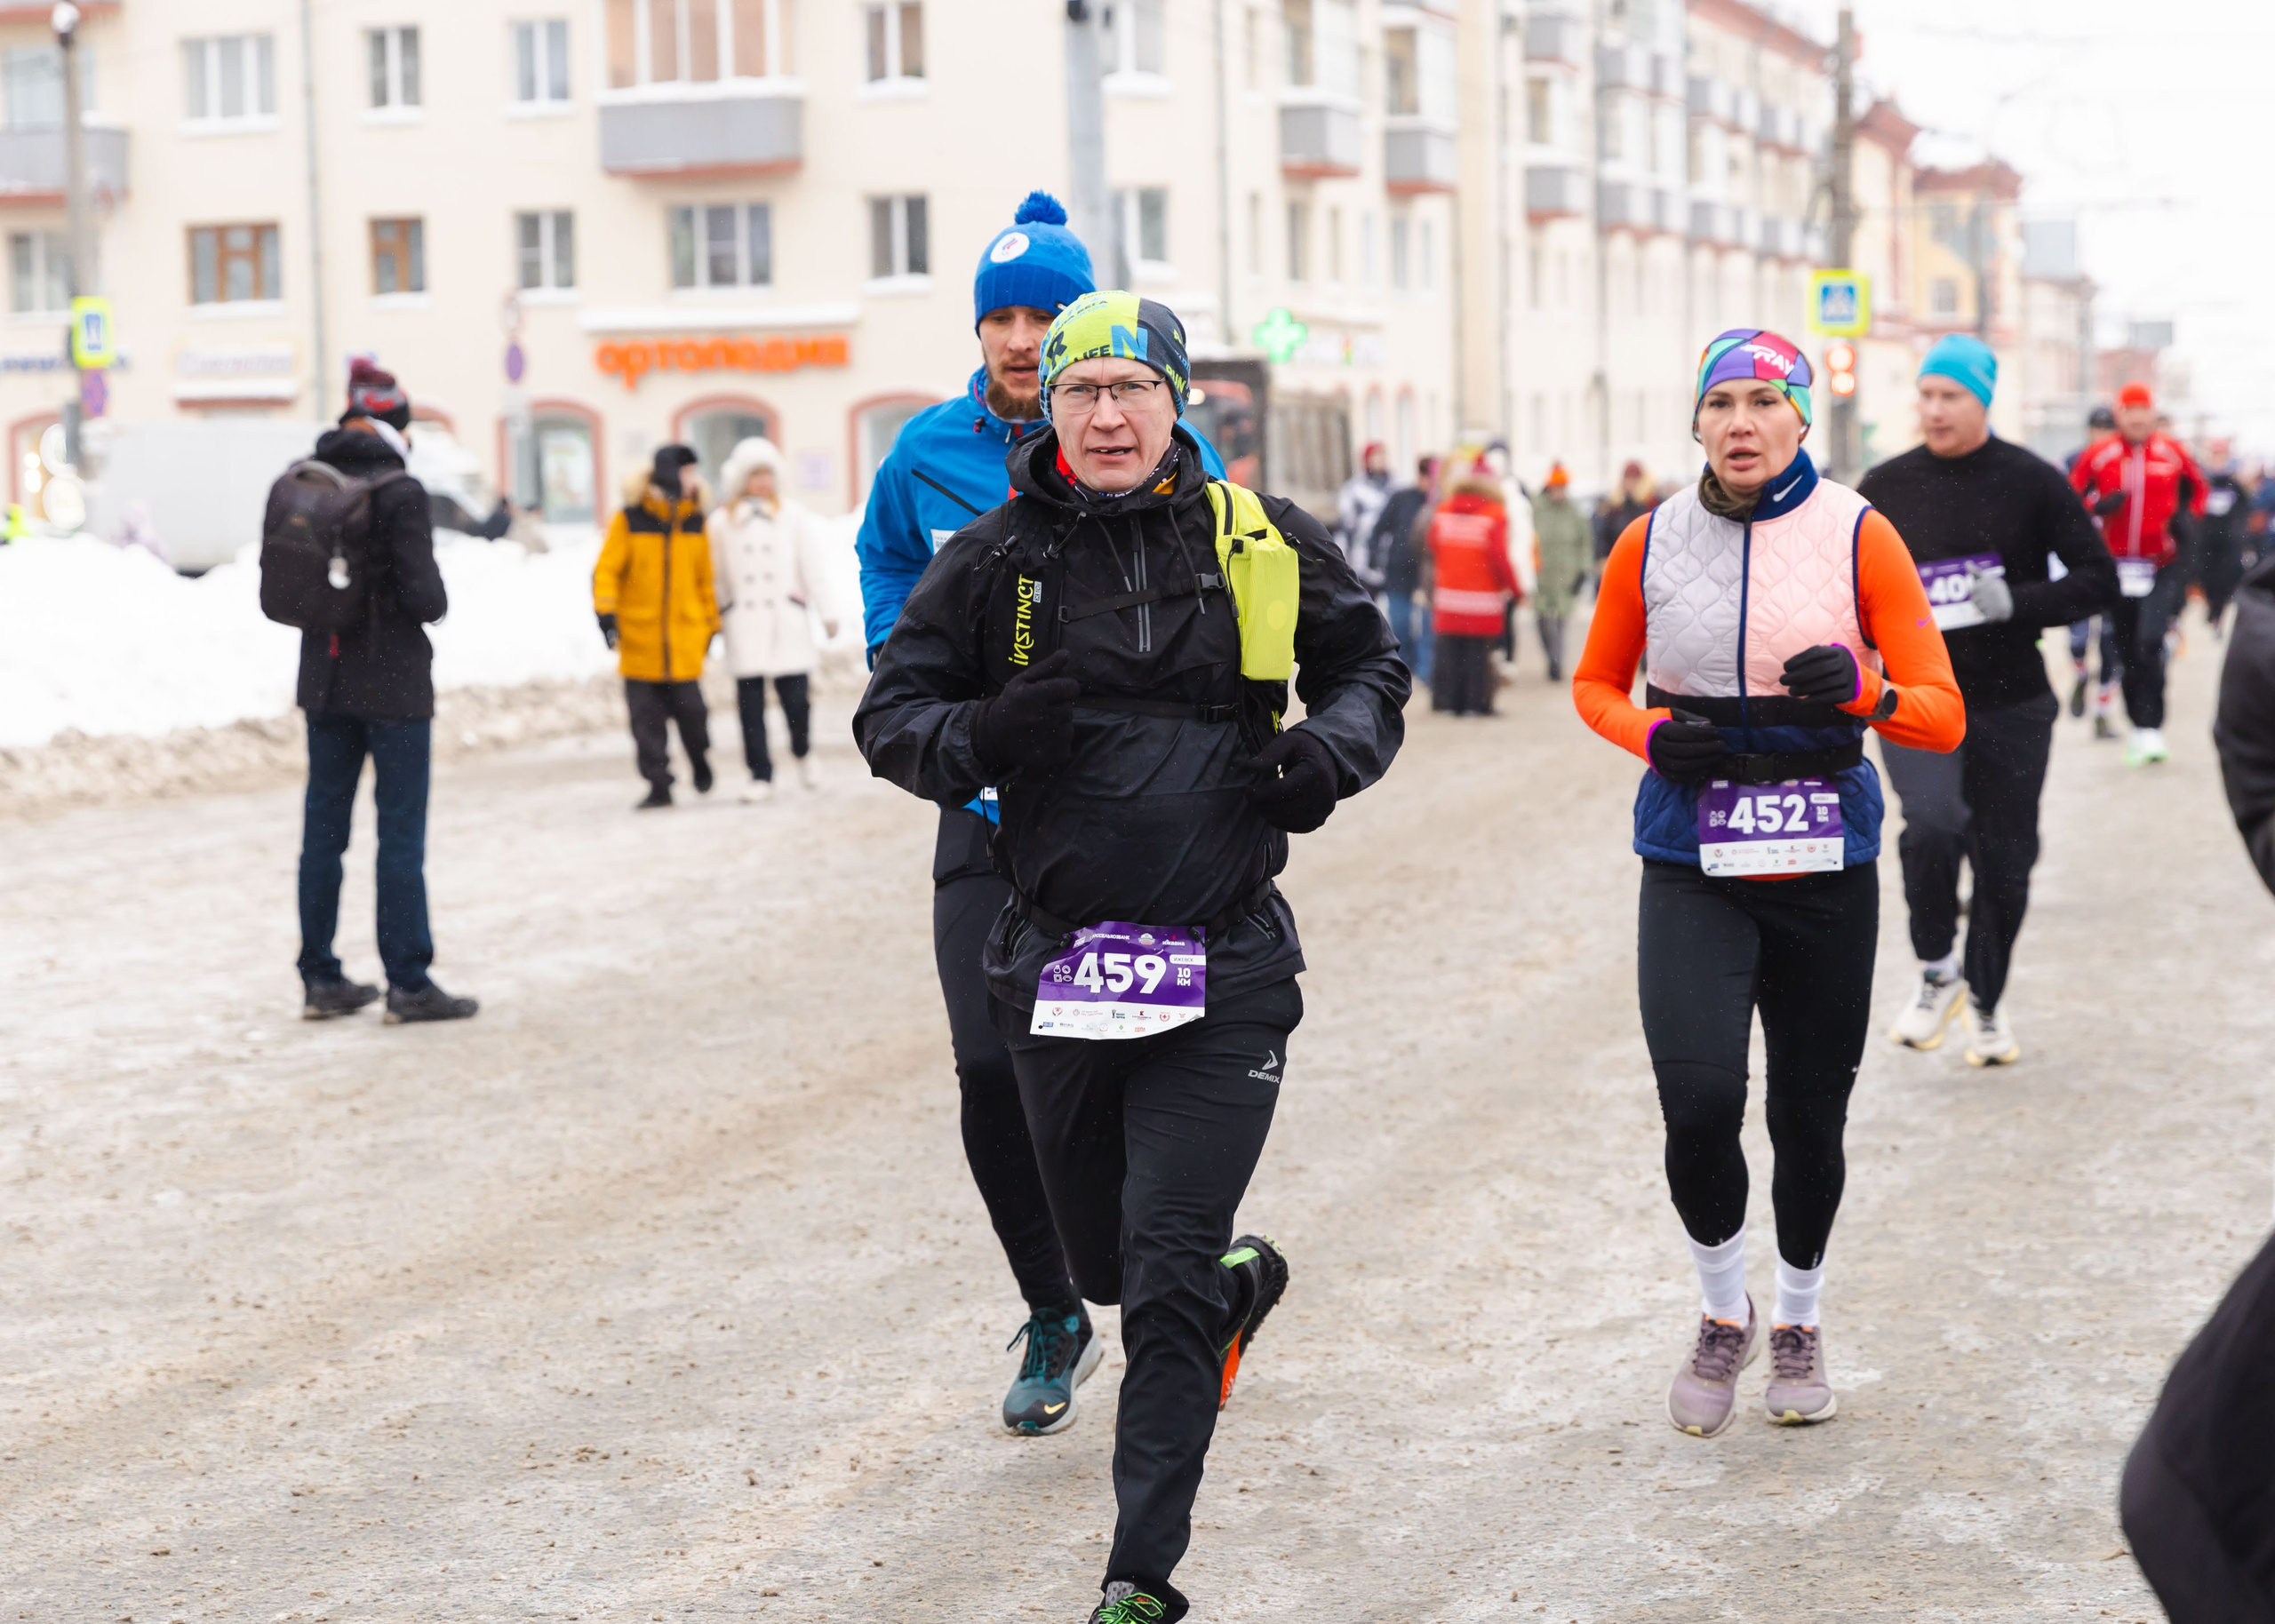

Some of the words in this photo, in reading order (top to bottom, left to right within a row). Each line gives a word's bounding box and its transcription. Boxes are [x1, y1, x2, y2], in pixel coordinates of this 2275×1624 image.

[1727, 793, 1809, 834] 452
[1074, 951, 1168, 994] 459
[1177, 967, 1191, 978] 10
[1248, 1069, 1281, 1084] DEMIX
